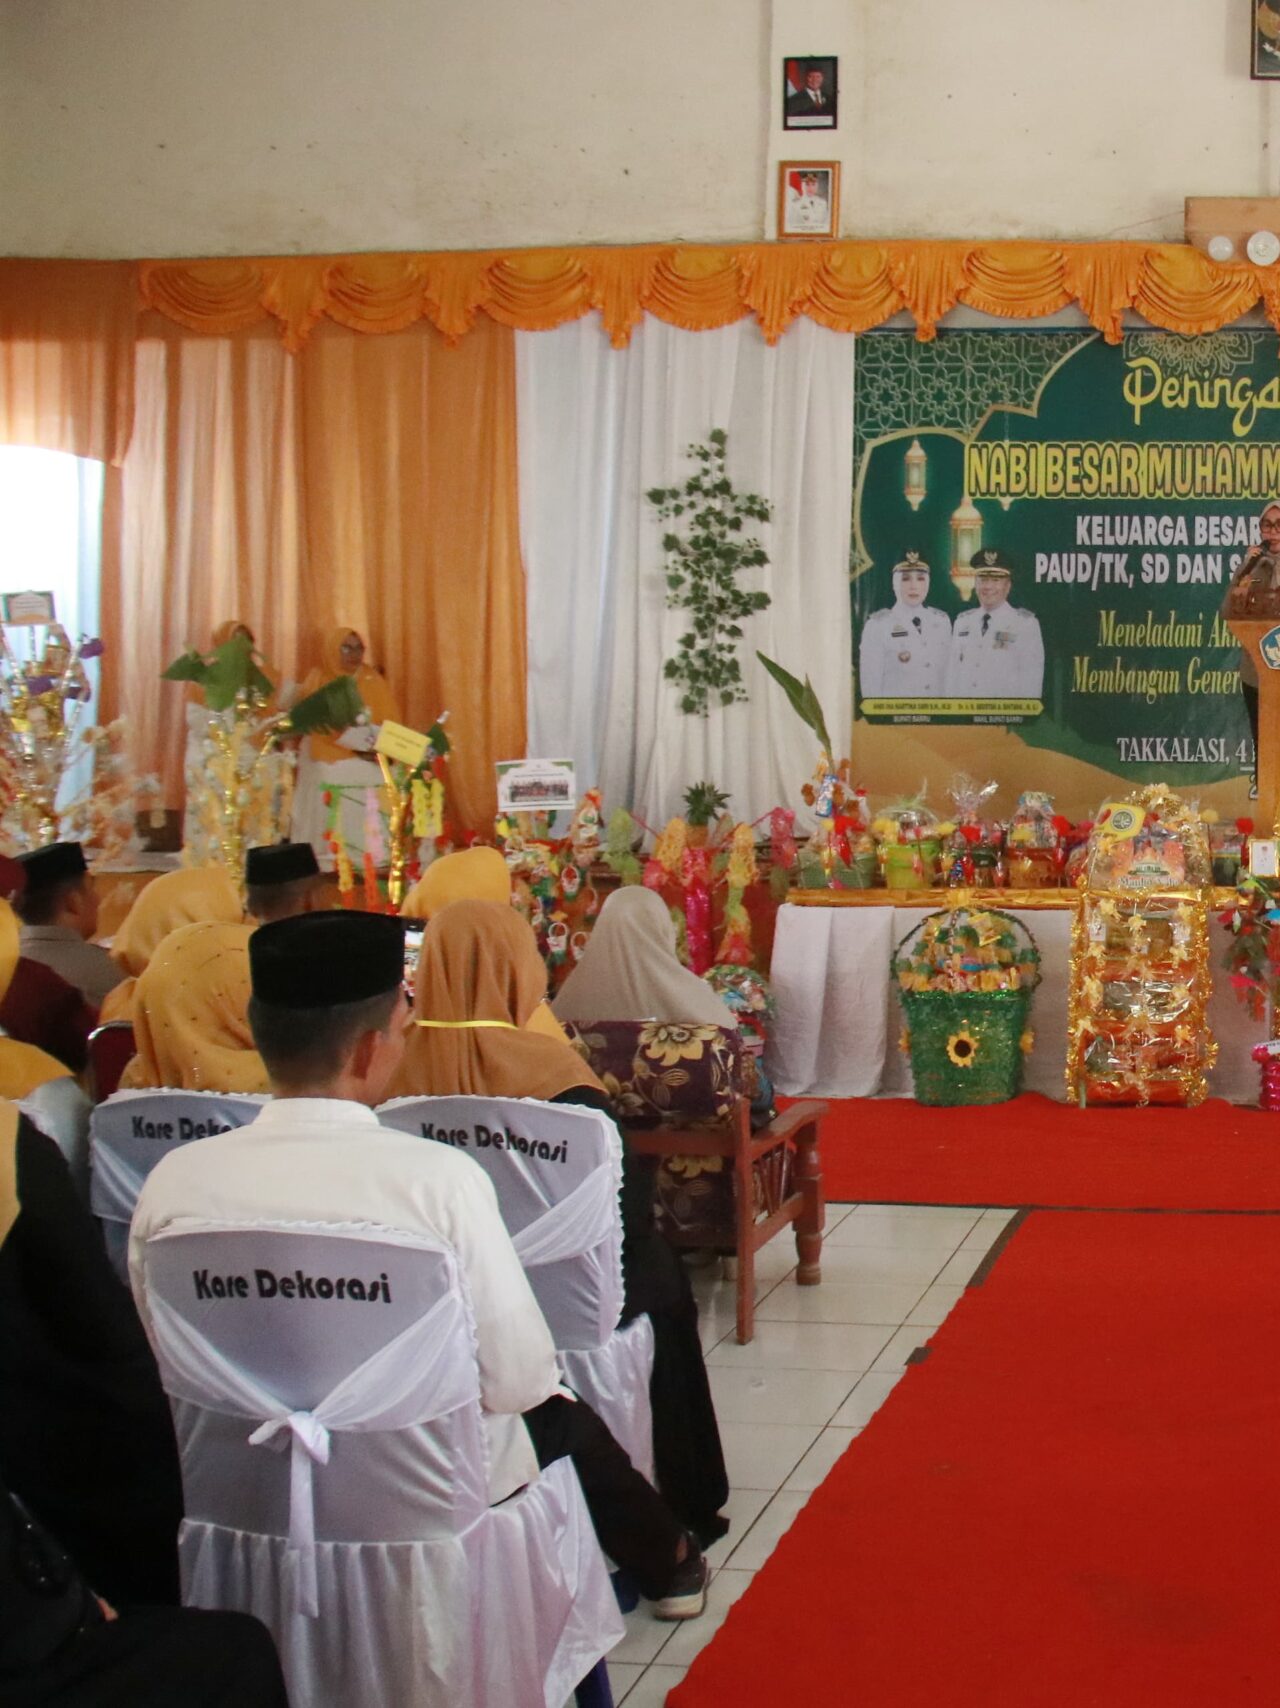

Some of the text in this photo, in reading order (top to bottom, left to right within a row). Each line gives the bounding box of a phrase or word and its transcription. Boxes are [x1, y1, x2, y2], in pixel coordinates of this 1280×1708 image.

[967, 441, 1038, 498] NABI
[1042, 441, 1143, 498] BESAR
[1076, 515, 1189, 546] KELUARGA
[1194, 515, 1263, 546] BESAR
[1035, 552, 1134, 591] PAUD/TK,
[1141, 553, 1170, 584] SD
[1177, 553, 1222, 584] DAN
[1097, 609, 1203, 648] Meneladani
[1071, 656, 1180, 704] Membangun
[1117, 737, 1231, 765] TAKKALASI,
[1235, 738, 1247, 764] 4
[132, 1115, 174, 1140] Kare
[421, 1122, 568, 1164] Kare Dekorasi
[192, 1268, 392, 1304] Kare Dekorasi
